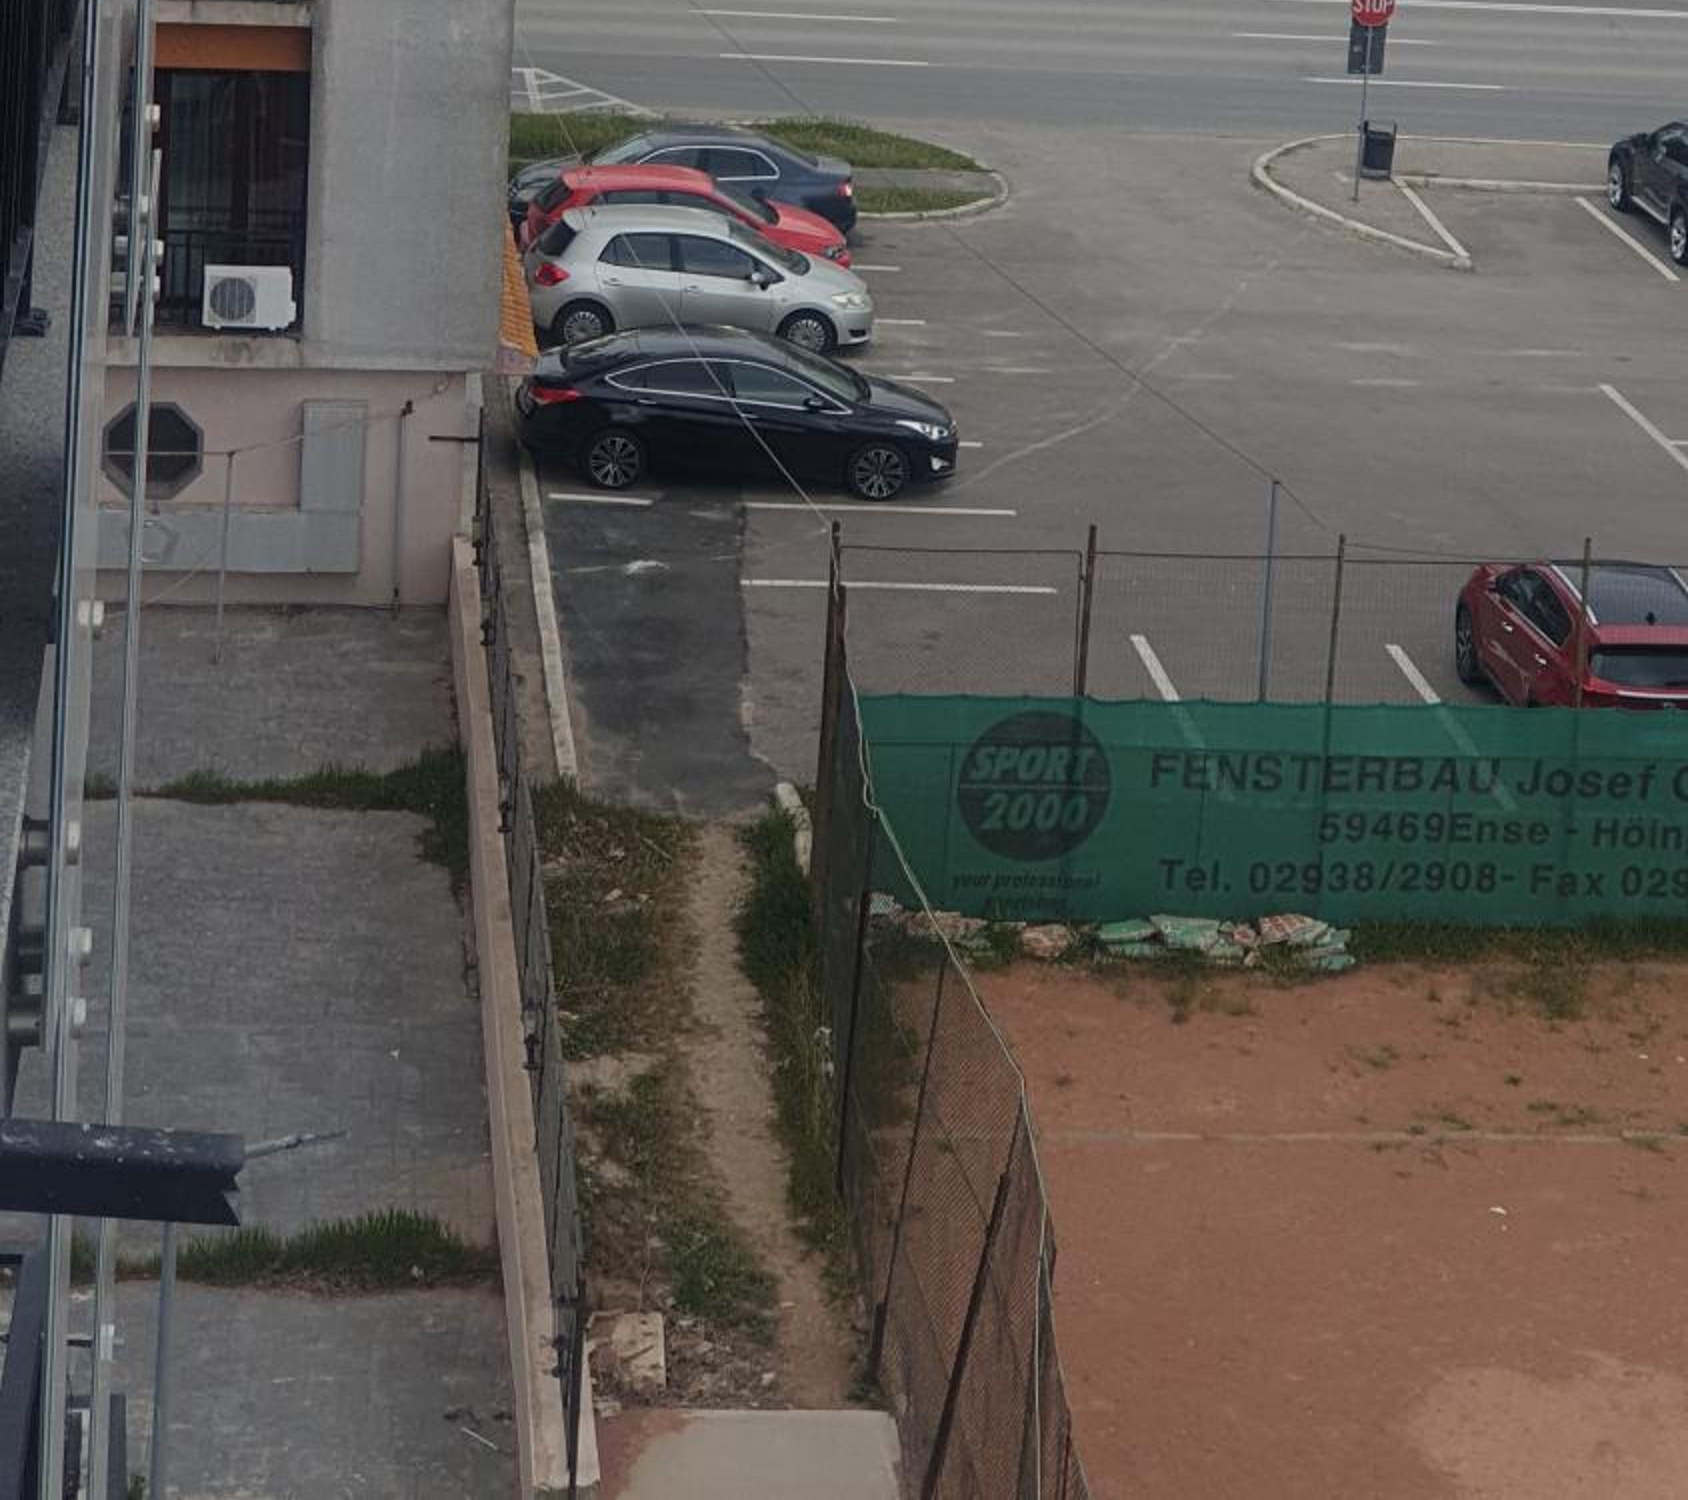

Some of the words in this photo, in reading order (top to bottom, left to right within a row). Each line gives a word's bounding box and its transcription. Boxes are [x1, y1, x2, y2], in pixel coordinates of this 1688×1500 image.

[969, 746, 1095, 781] SPORT
[1150, 753, 1500, 794] FENSTERBAU
[1517, 760, 1656, 799] Josef
[980, 794, 1088, 831] 2000
[1160, 858, 1231, 892] Tel.
[1529, 864, 1605, 897] Fax
